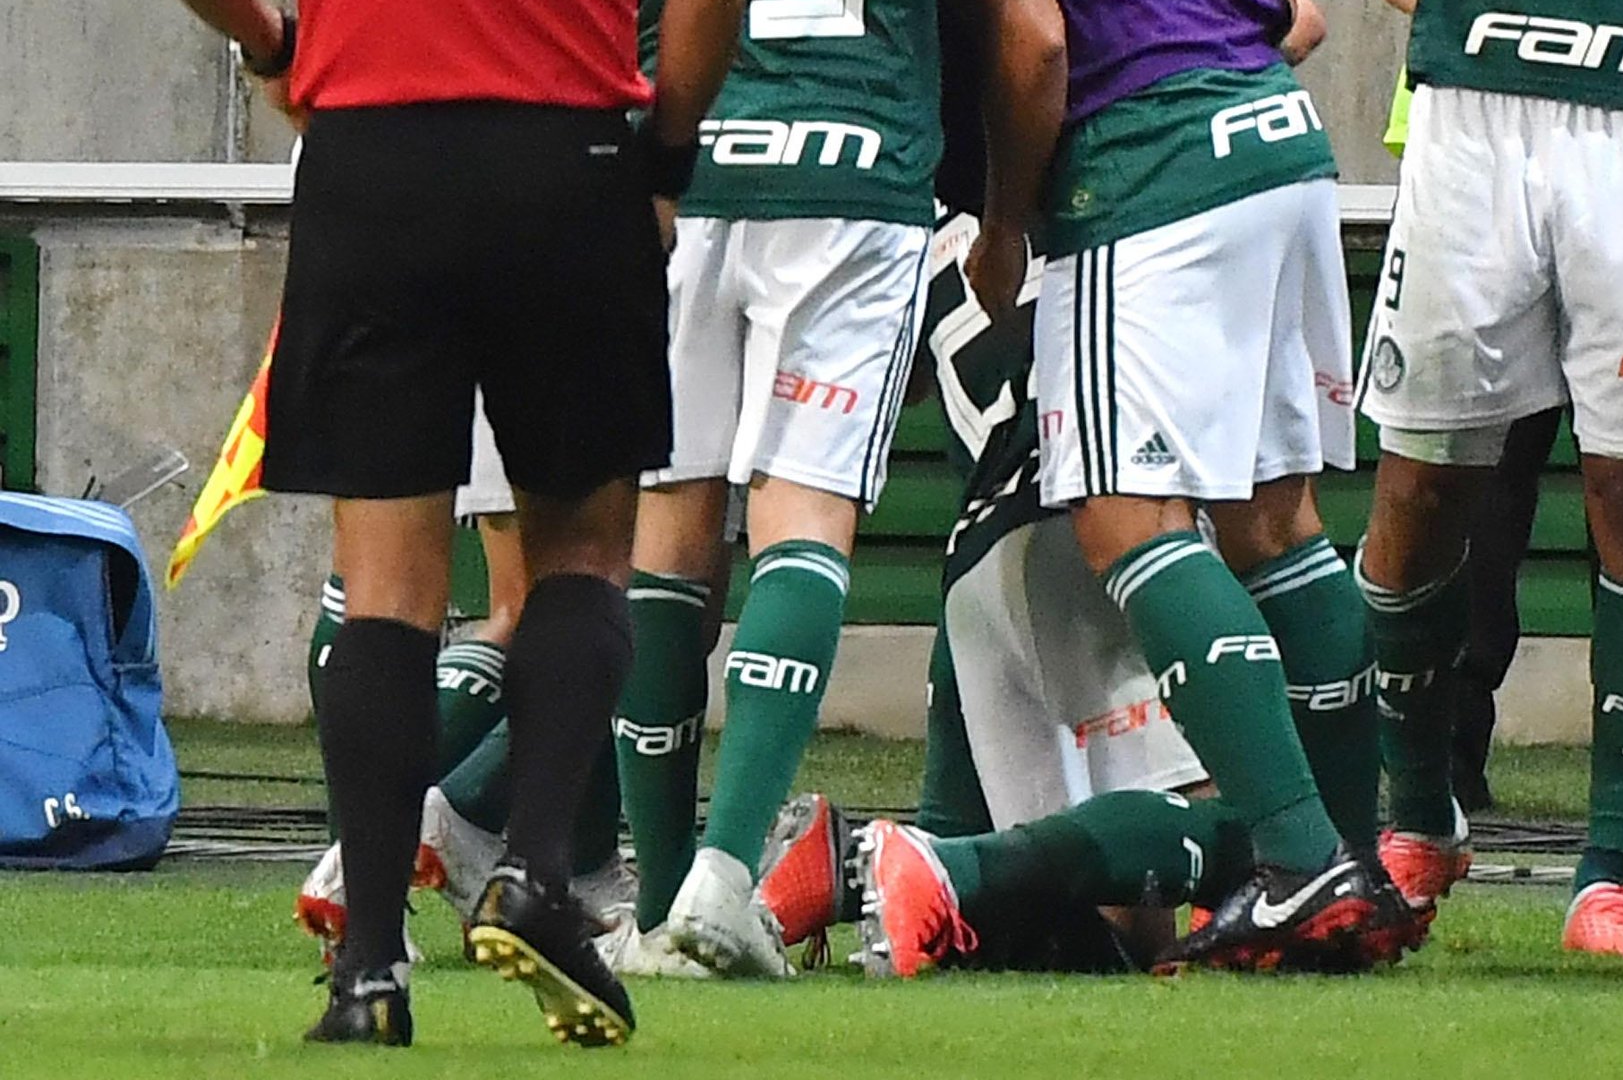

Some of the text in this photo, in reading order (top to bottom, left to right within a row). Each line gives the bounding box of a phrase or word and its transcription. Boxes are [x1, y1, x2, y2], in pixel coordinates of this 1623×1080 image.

[1385, 248, 1406, 311] 9
[772, 369, 858, 415] am
[1206, 634, 1281, 664] Fa
